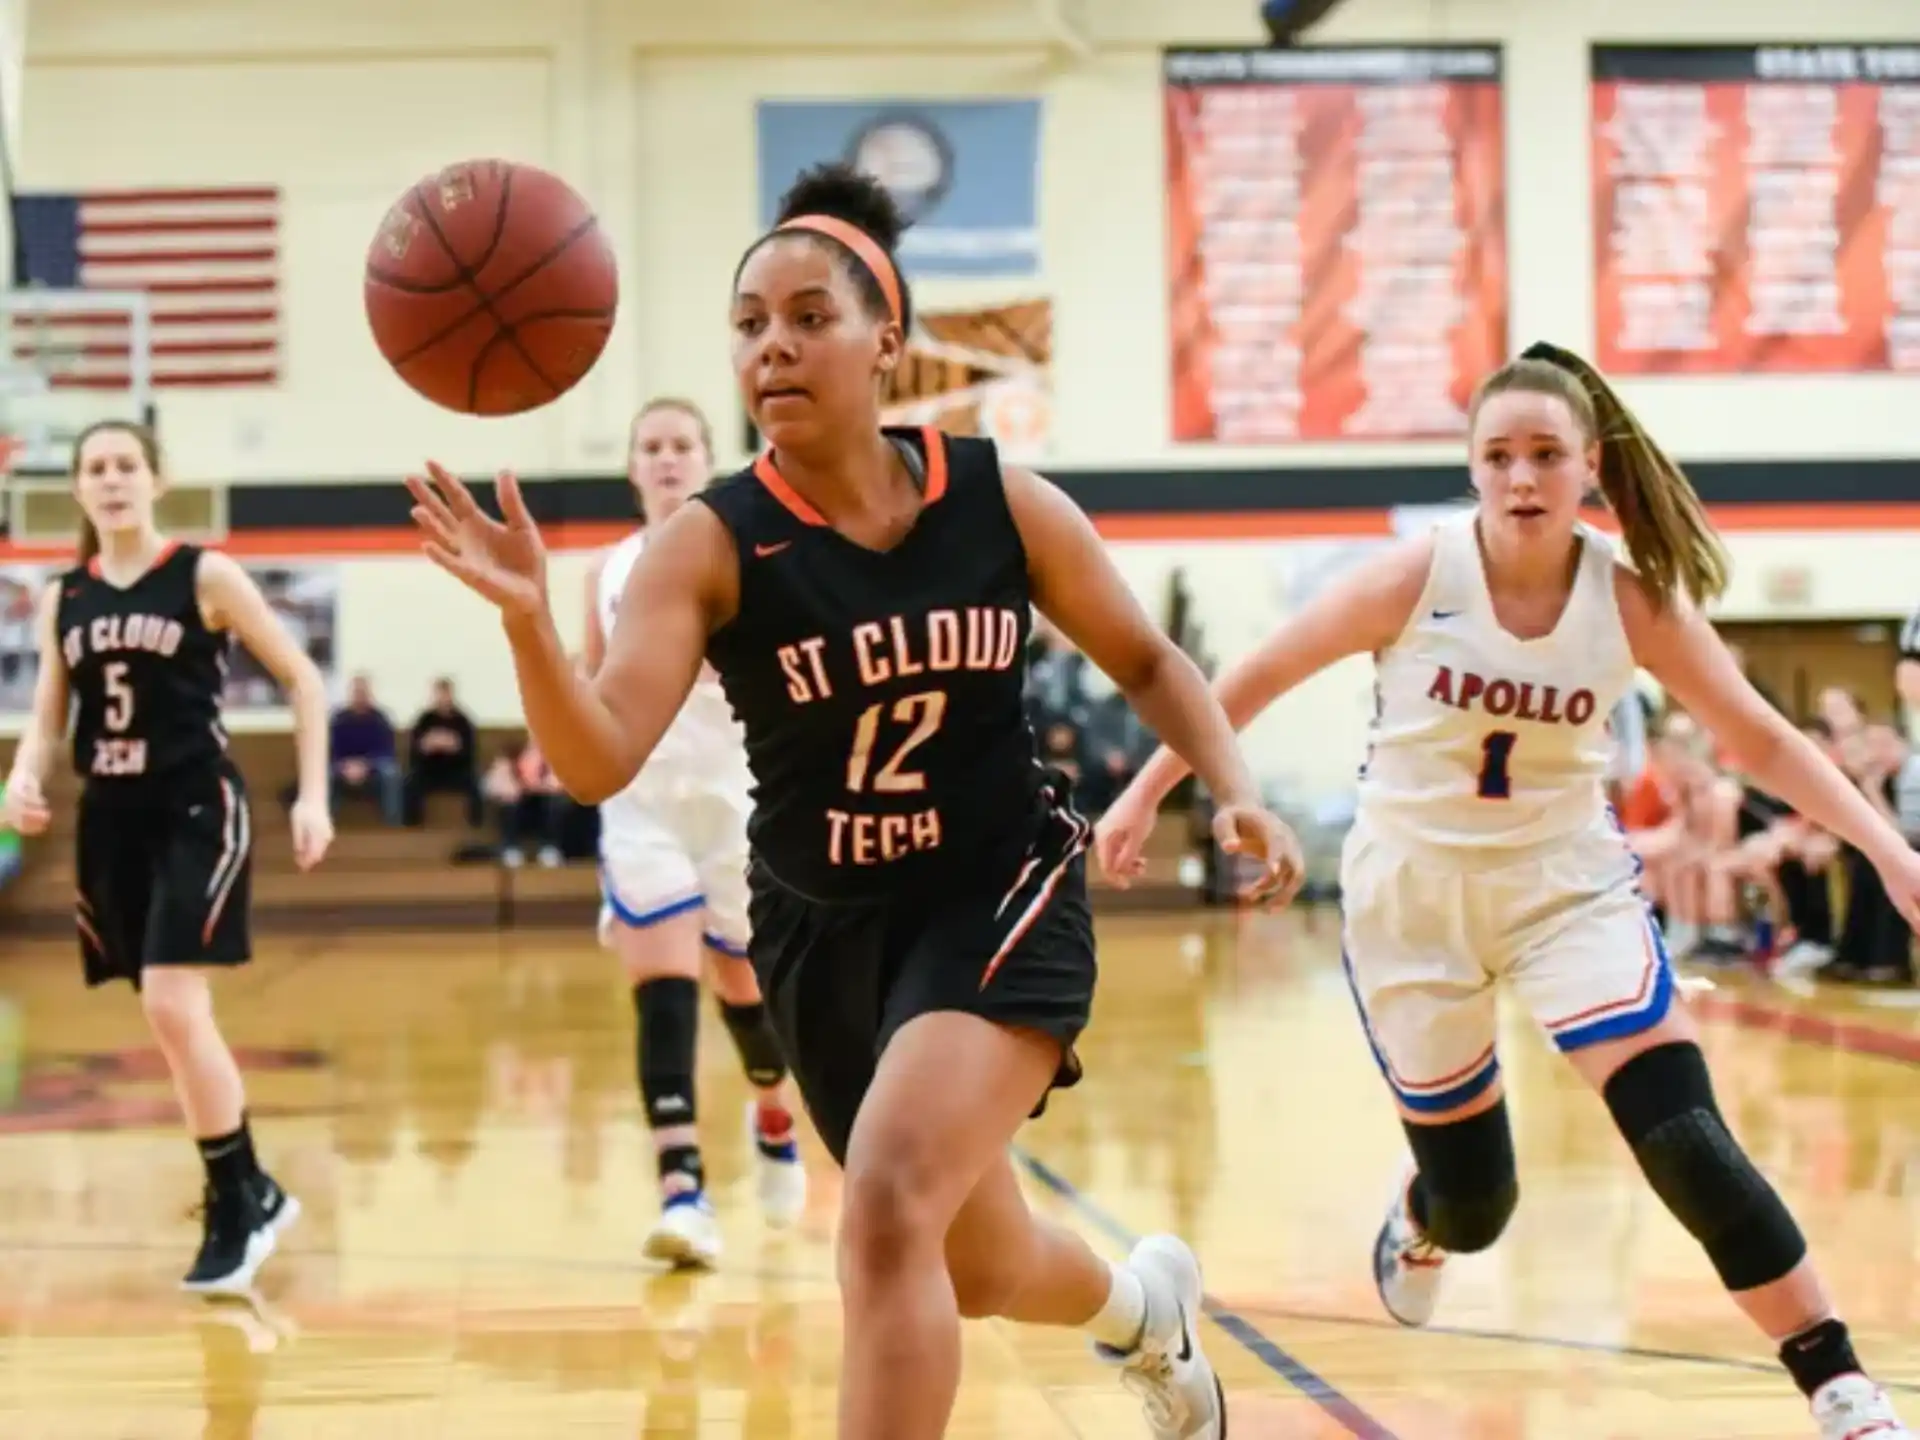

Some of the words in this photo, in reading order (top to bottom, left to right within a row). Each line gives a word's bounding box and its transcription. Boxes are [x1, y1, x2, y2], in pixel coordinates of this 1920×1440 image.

[90, 612, 185, 658] CLOUD
[776, 636, 833, 703] ST
[852, 607, 1018, 687] CLOUD
[104, 660, 135, 732] 5
[1426, 665, 1597, 726] APOLLO
[845, 689, 948, 793] 12
[1476, 729, 1518, 799] 1
[825, 808, 942, 865] TECH
